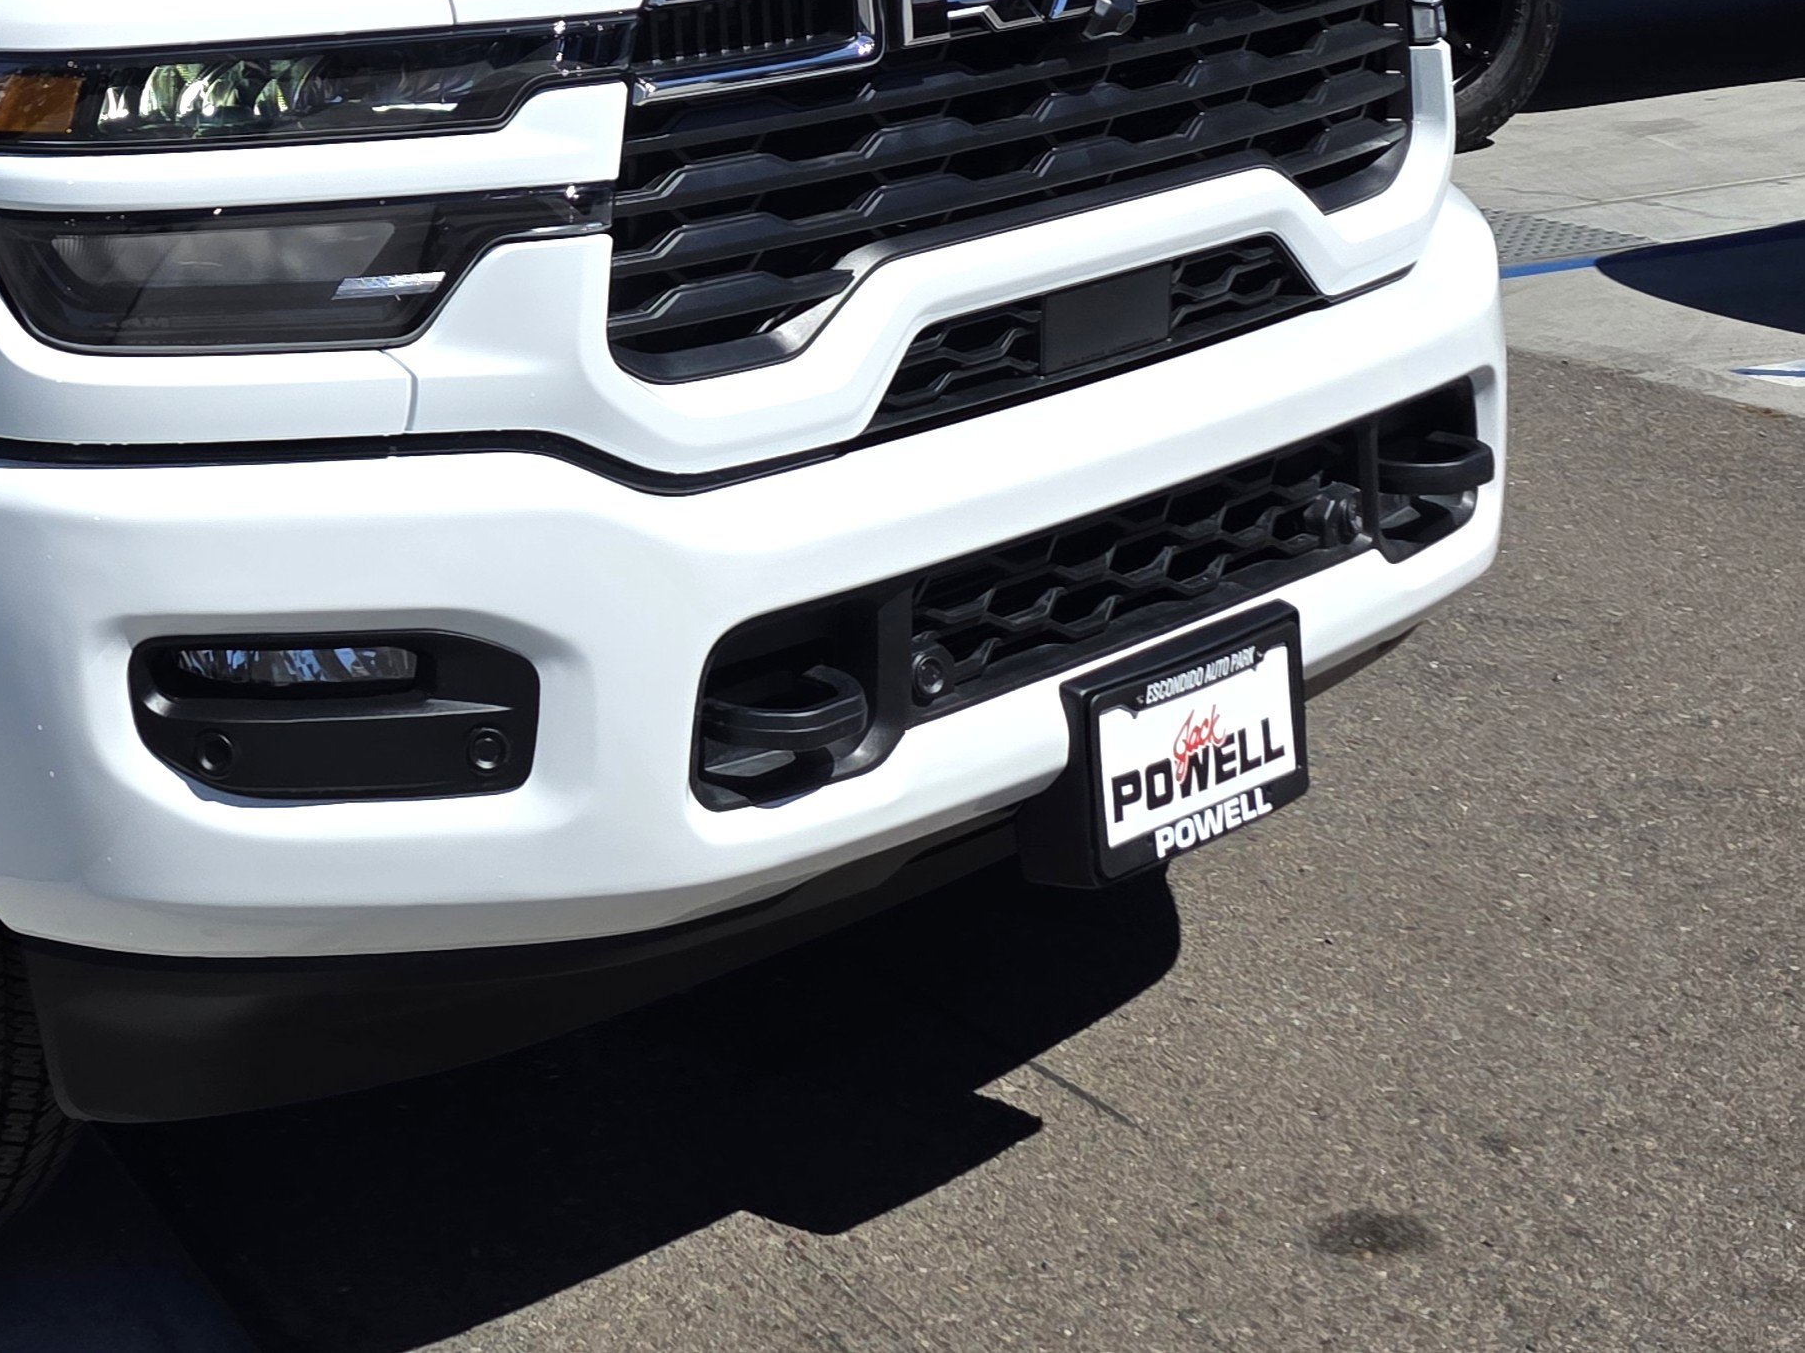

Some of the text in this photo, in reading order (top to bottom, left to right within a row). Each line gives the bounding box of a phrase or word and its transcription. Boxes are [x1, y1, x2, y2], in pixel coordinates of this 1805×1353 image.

[1145, 646, 1256, 704] ESCONDIDO AUTO PARK
[1111, 717, 1286, 824] POWELL
[1173, 704, 1227, 783] Jack
[1155, 787, 1274, 859] POWELL
